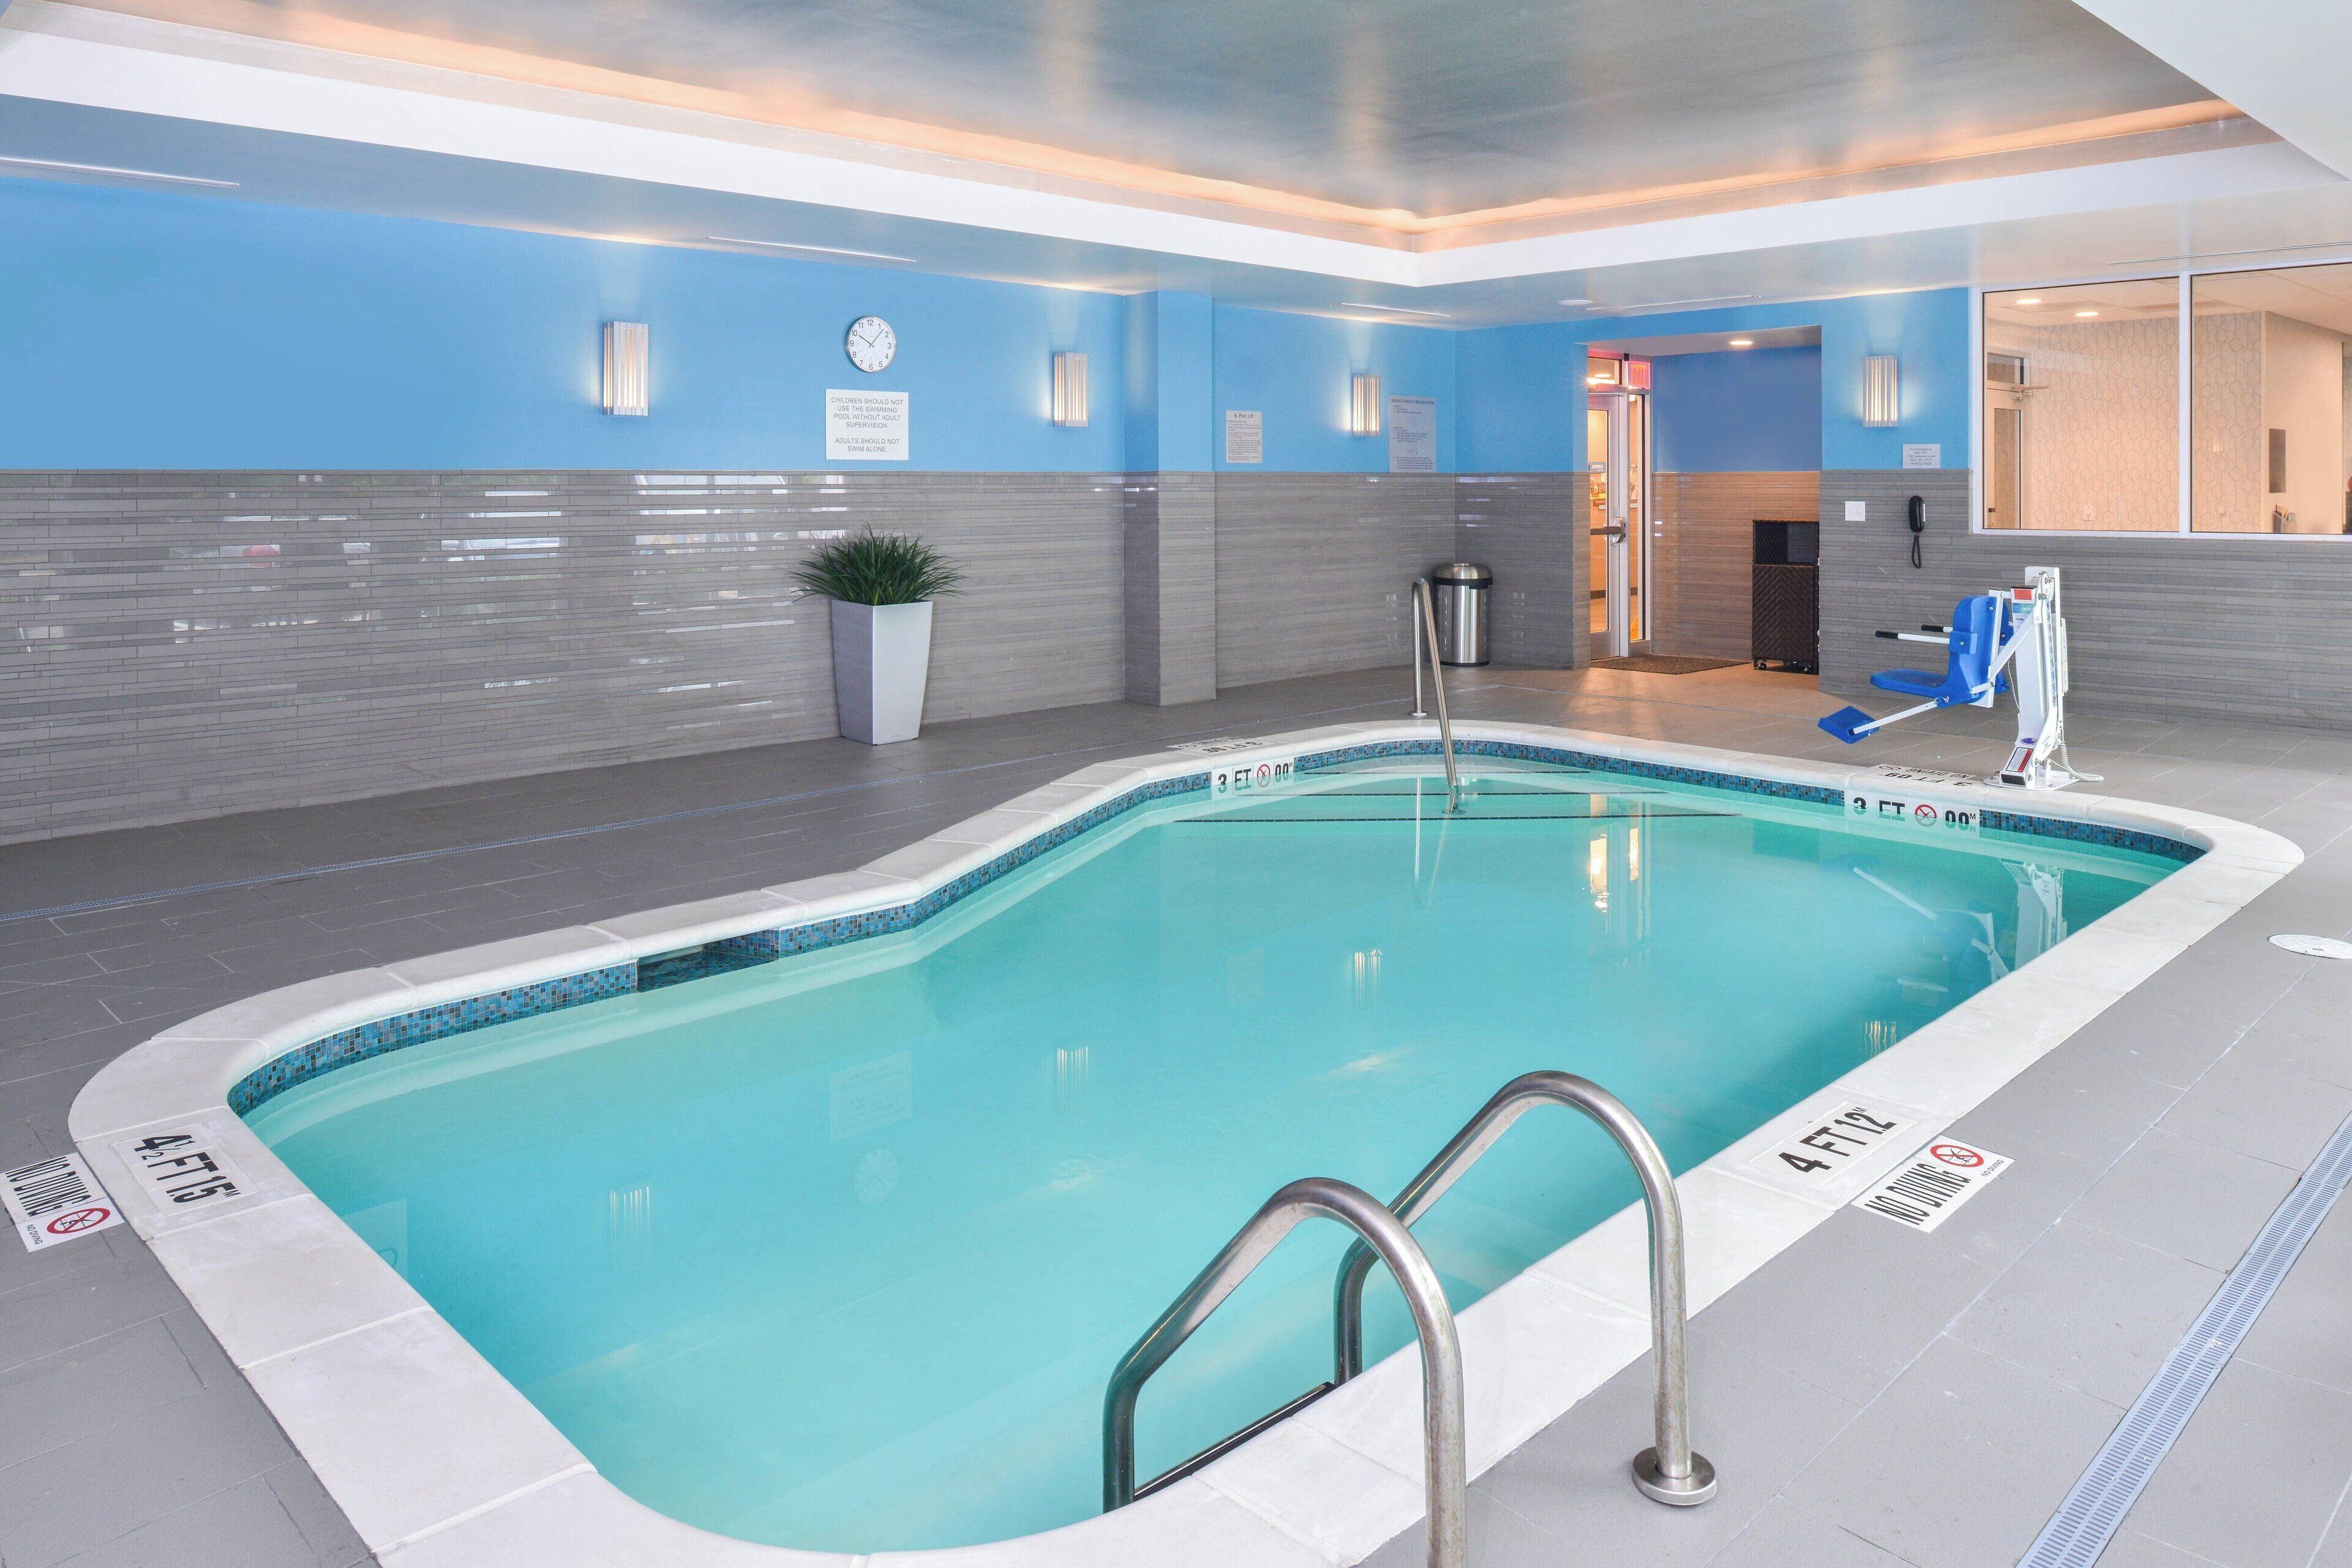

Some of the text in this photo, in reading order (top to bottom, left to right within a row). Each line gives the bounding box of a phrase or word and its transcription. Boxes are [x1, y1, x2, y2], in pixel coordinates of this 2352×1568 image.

[1799, 1126, 1868, 1157] FT
[148, 1152, 220, 1181] FT
[1777, 1152, 1832, 1173] 4
[1988, 1159, 2004, 1173] DIVING
[5, 1156, 92, 1217] NO DIVING
[1864, 1163, 1972, 1225] NO DIVING
[26, 1224, 43, 1245] NO DIVING
